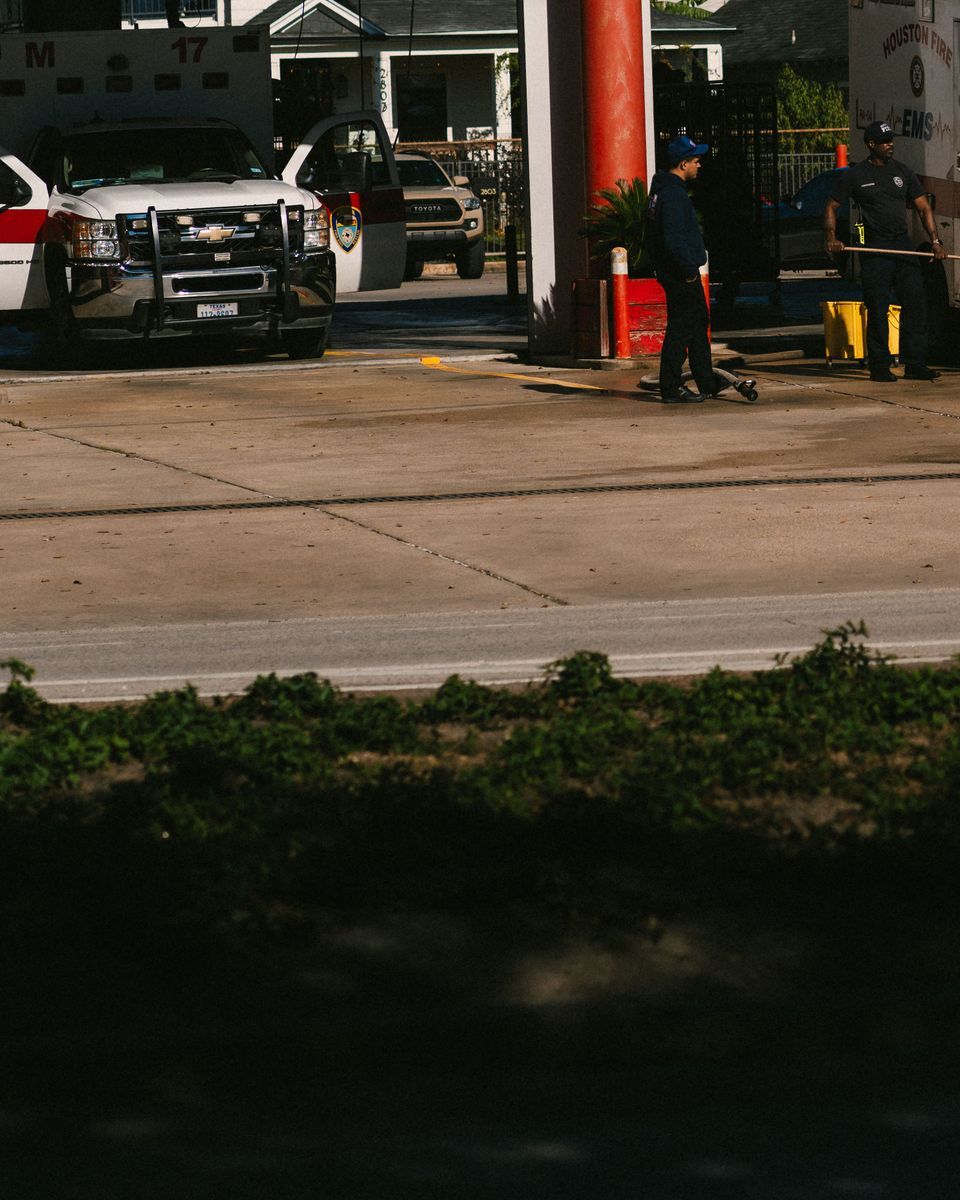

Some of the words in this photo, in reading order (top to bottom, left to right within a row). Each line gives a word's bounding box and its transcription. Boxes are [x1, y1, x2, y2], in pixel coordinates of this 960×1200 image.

[25, 41, 55, 68] M
[170, 36, 209, 64] 17
[882, 23, 929, 59] HOUSTON
[930, 30, 953, 69] FIRE
[901, 108, 934, 142] EMS
